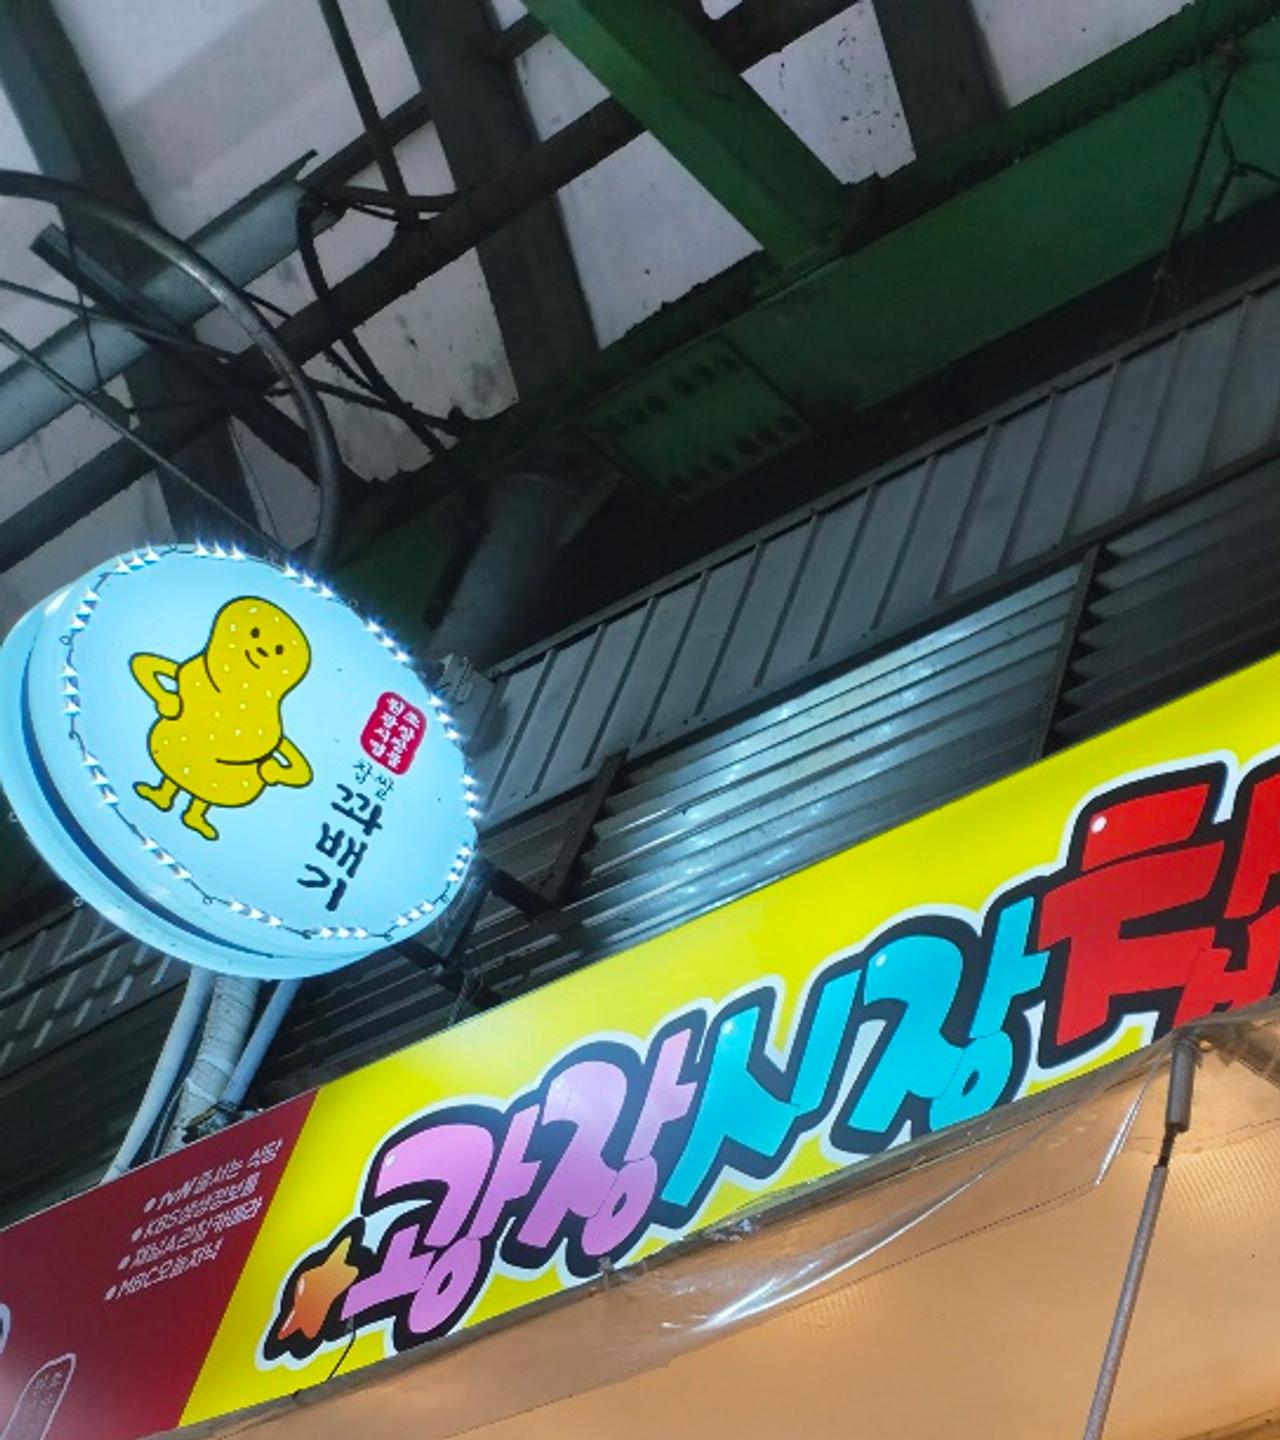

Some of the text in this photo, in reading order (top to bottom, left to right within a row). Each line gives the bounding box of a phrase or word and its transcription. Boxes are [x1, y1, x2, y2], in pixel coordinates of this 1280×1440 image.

[352, 758, 395, 801] 찹쌀
[296, 783, 384, 913] 꽈배기
[340, 893, 1052, 1340] 광장시장
